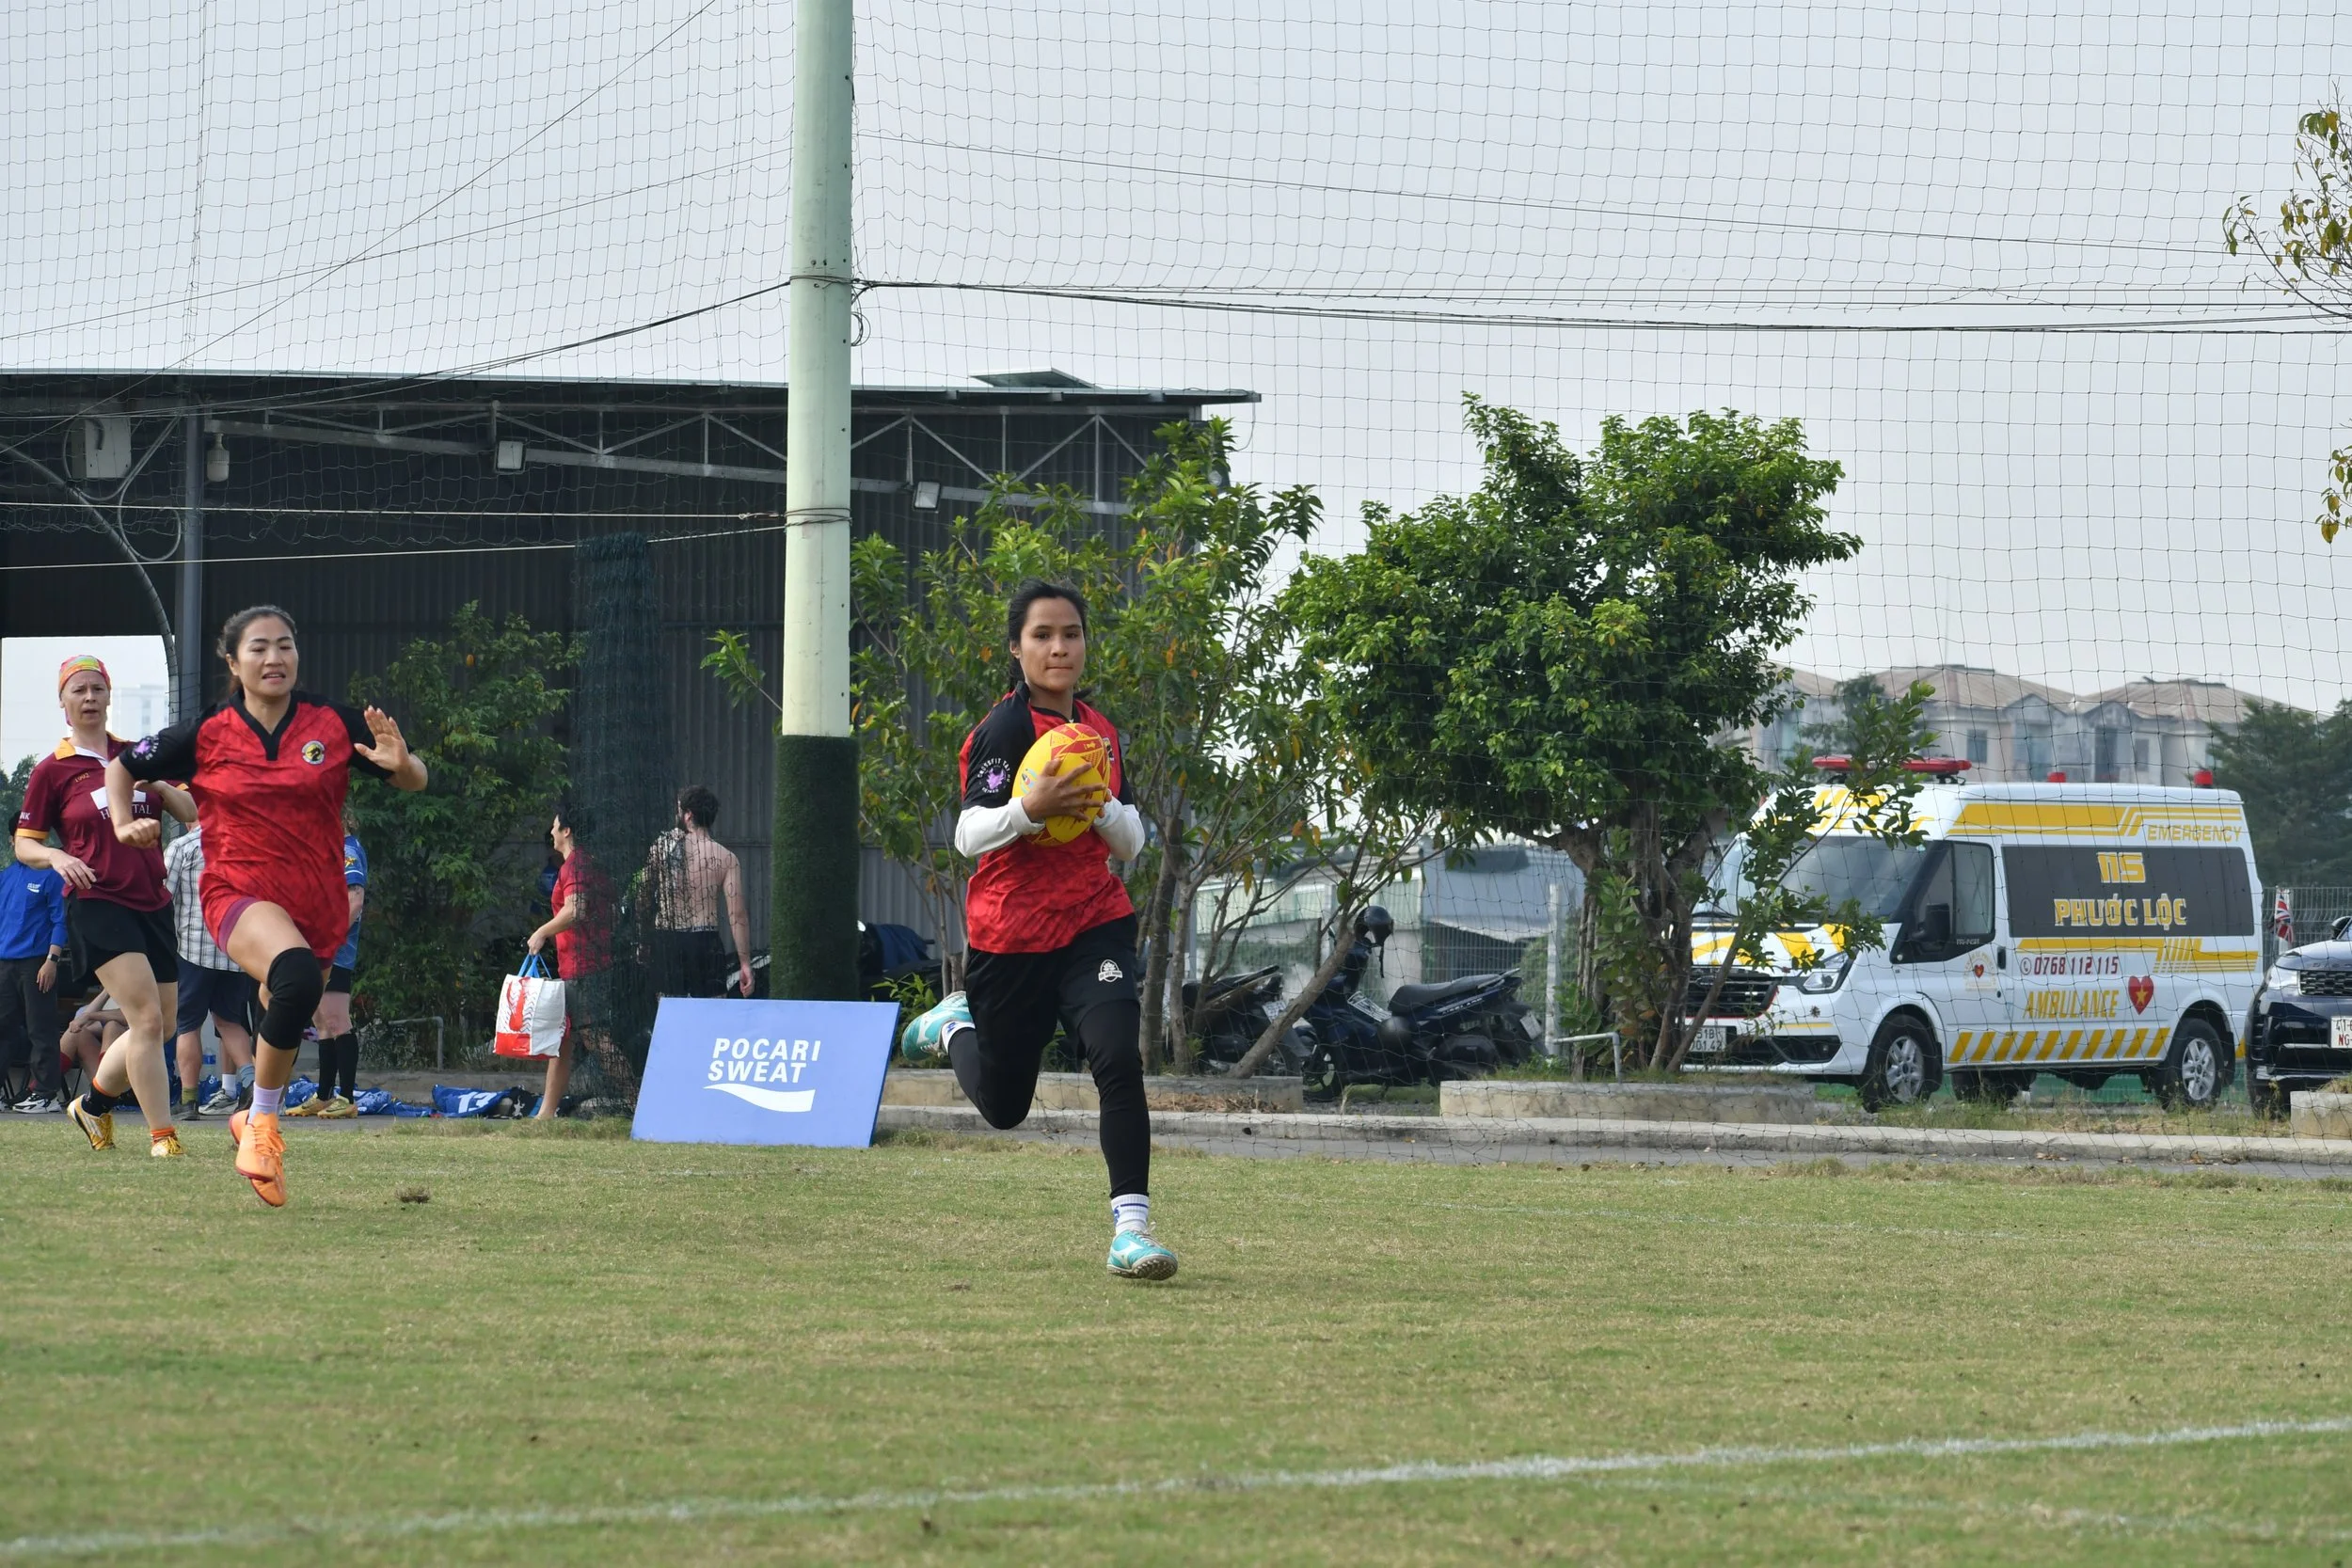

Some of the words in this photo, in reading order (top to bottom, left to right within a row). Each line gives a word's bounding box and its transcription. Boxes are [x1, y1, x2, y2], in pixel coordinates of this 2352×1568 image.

[2147, 824, 2242, 843] EMERGENCY
[2141, 893, 2187, 931] LỘC
[2023, 990, 2120, 1020] AMBULANCE
[712, 1037, 821, 1062] POCARI
[707, 1060, 806, 1083] SWEAT
